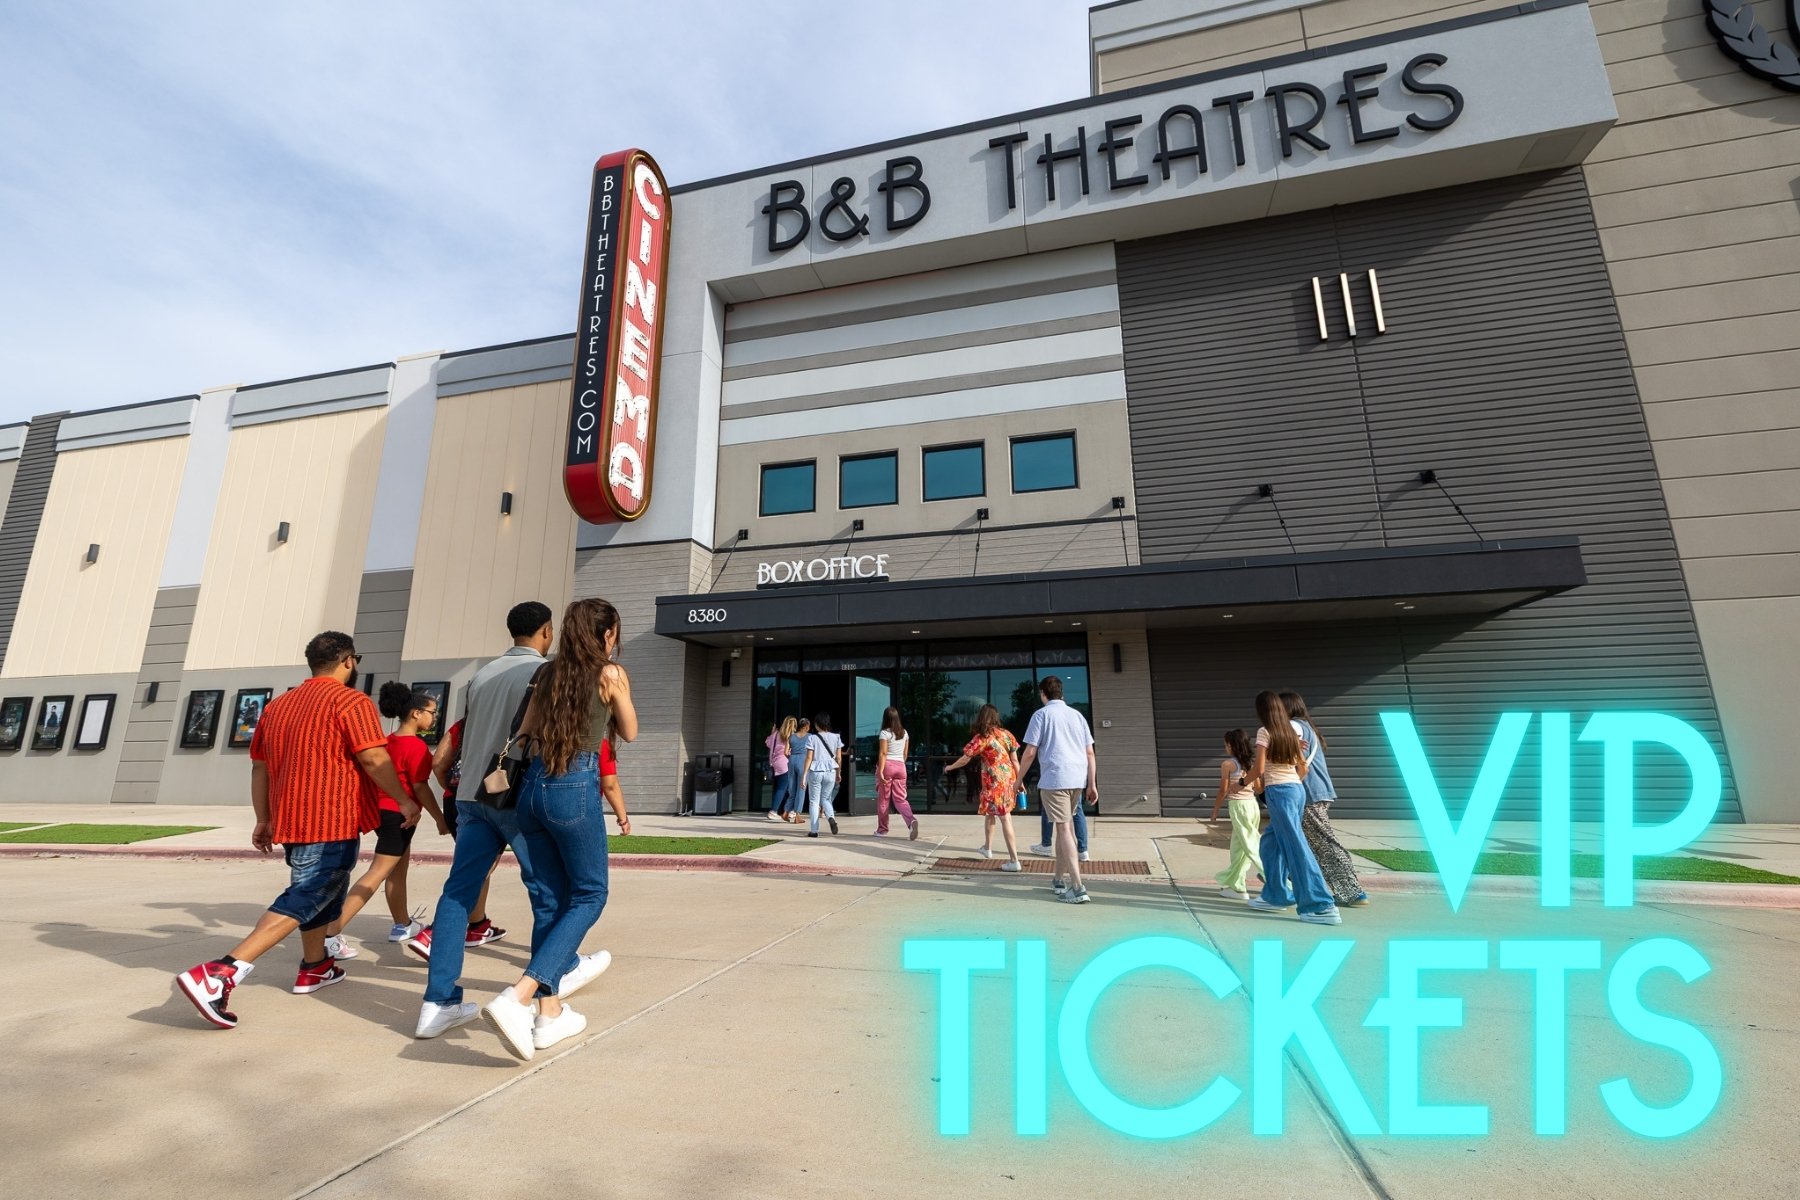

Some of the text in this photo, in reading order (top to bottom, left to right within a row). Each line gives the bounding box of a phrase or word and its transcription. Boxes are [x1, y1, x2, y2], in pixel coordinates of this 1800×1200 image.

[761, 52, 1465, 252] B&B THEATRES
[576, 174, 615, 455] BBTHEATRES.COM
[608, 163, 663, 500] CINEMA
[687, 608, 727, 623] 8380
[757, 554, 890, 585] BOX OFFICE
